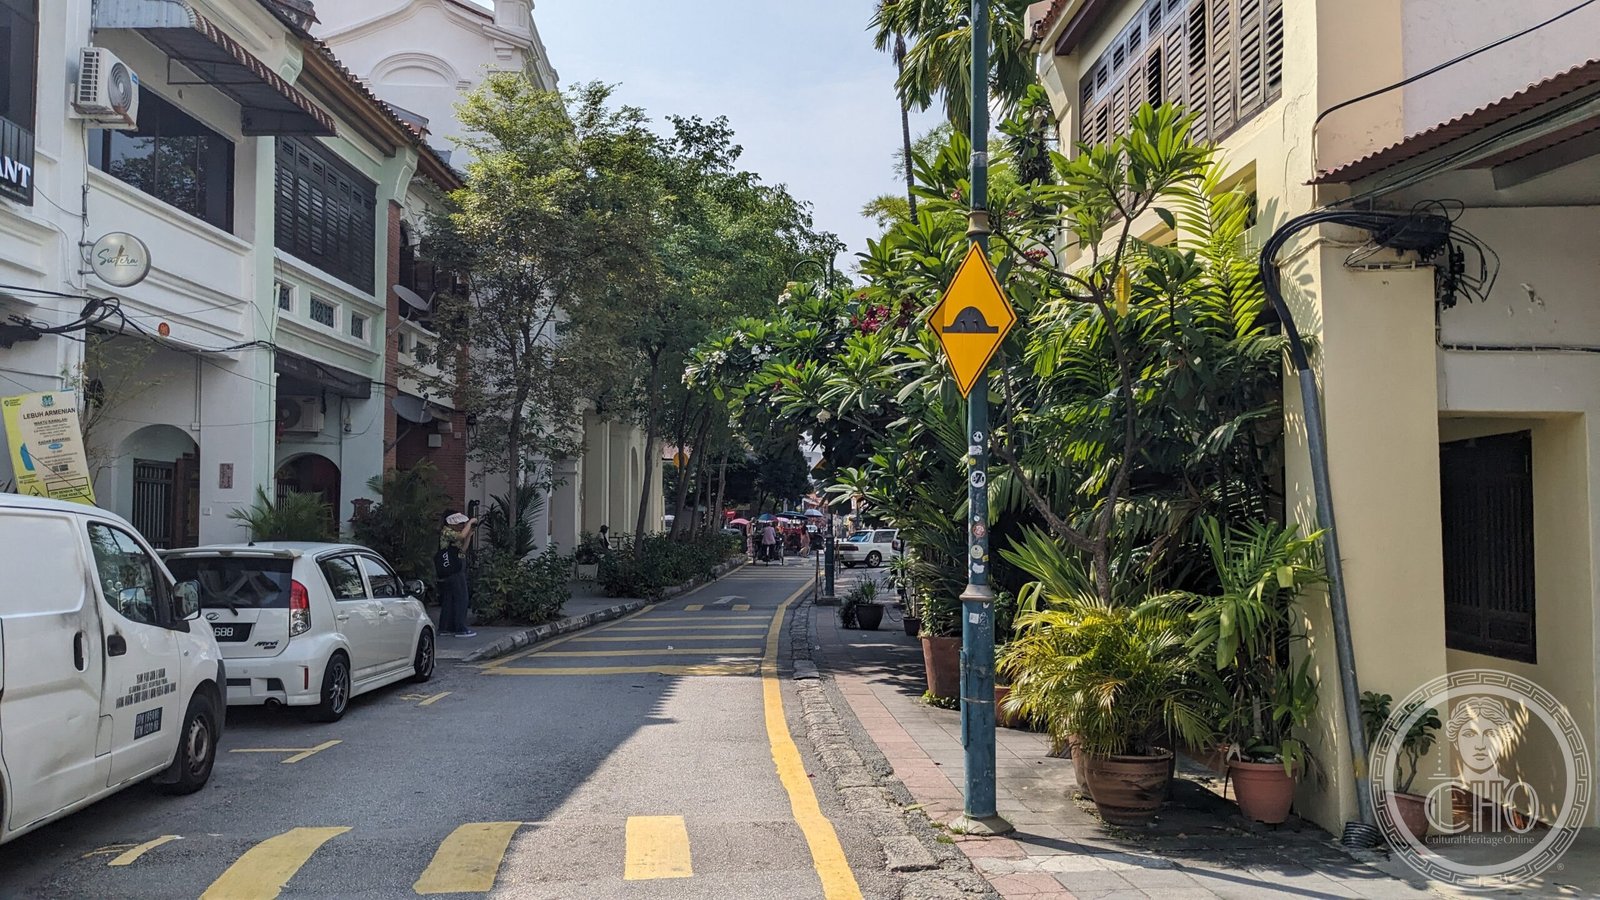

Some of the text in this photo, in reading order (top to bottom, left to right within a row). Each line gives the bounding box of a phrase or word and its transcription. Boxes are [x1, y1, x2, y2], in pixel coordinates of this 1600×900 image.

[0, 155, 31, 188] NT
[23, 407, 76, 420] LEBUH ARMENIAN
